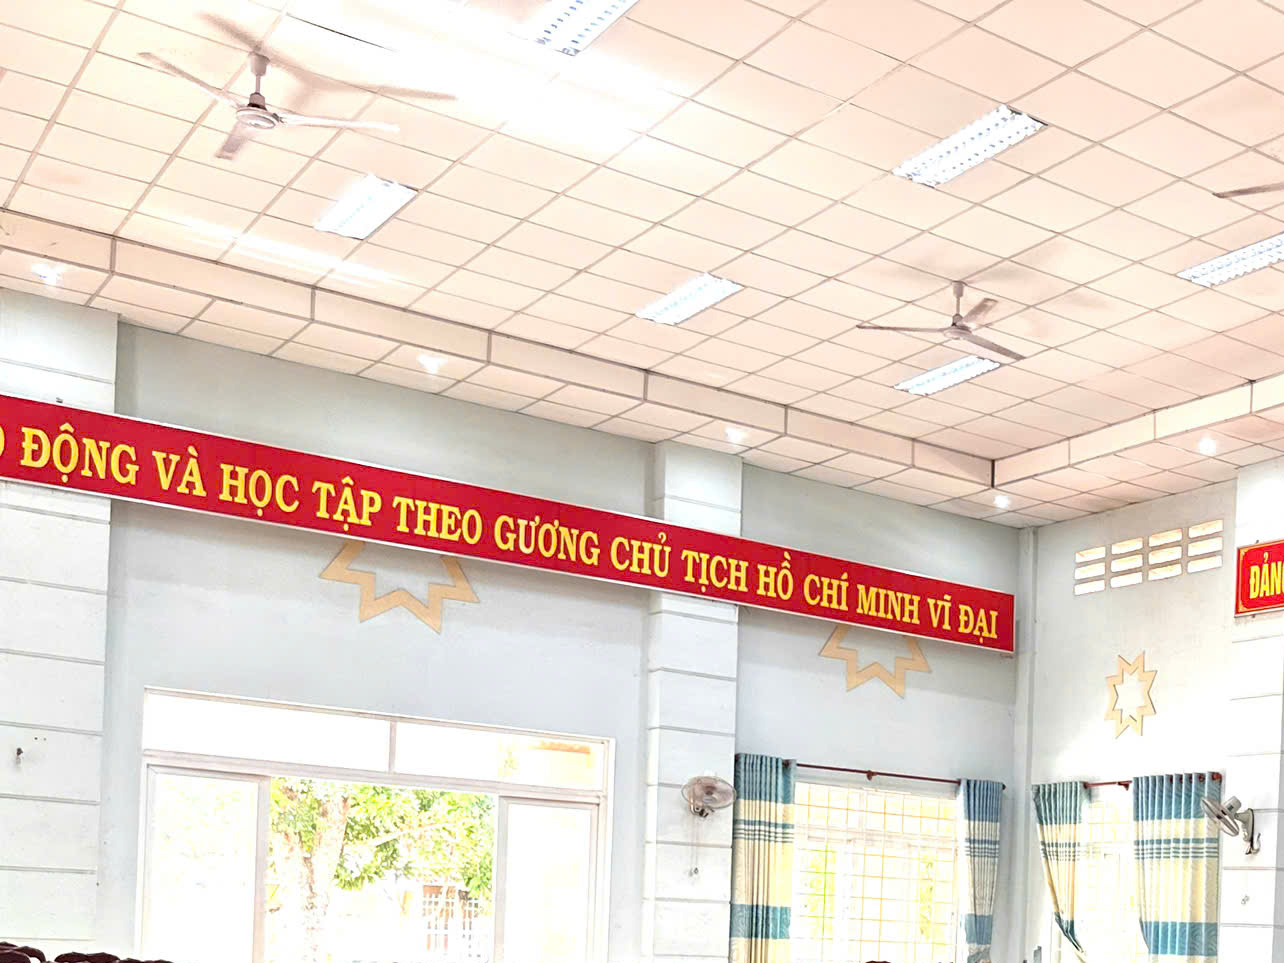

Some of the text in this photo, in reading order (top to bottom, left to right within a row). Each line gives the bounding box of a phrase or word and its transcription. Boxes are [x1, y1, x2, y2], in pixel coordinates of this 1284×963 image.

[21, 424, 139, 484] ĐỘNG
[152, 446, 206, 496] VÀ
[219, 464, 300, 517] HỌC
[312, 476, 381, 531] TẬP
[393, 496, 482, 544] THEO
[495, 516, 600, 565] GƯƠNG
[611, 532, 671, 577] CHỦ
[681, 550, 748, 592] TỊCH
[757, 552, 793, 600] HỒ
[804, 573, 848, 610] CHÍ
[856, 585, 920, 625] MINH
[928, 595, 951, 630] VĨ
[958, 606, 998, 644] ĐẠI
